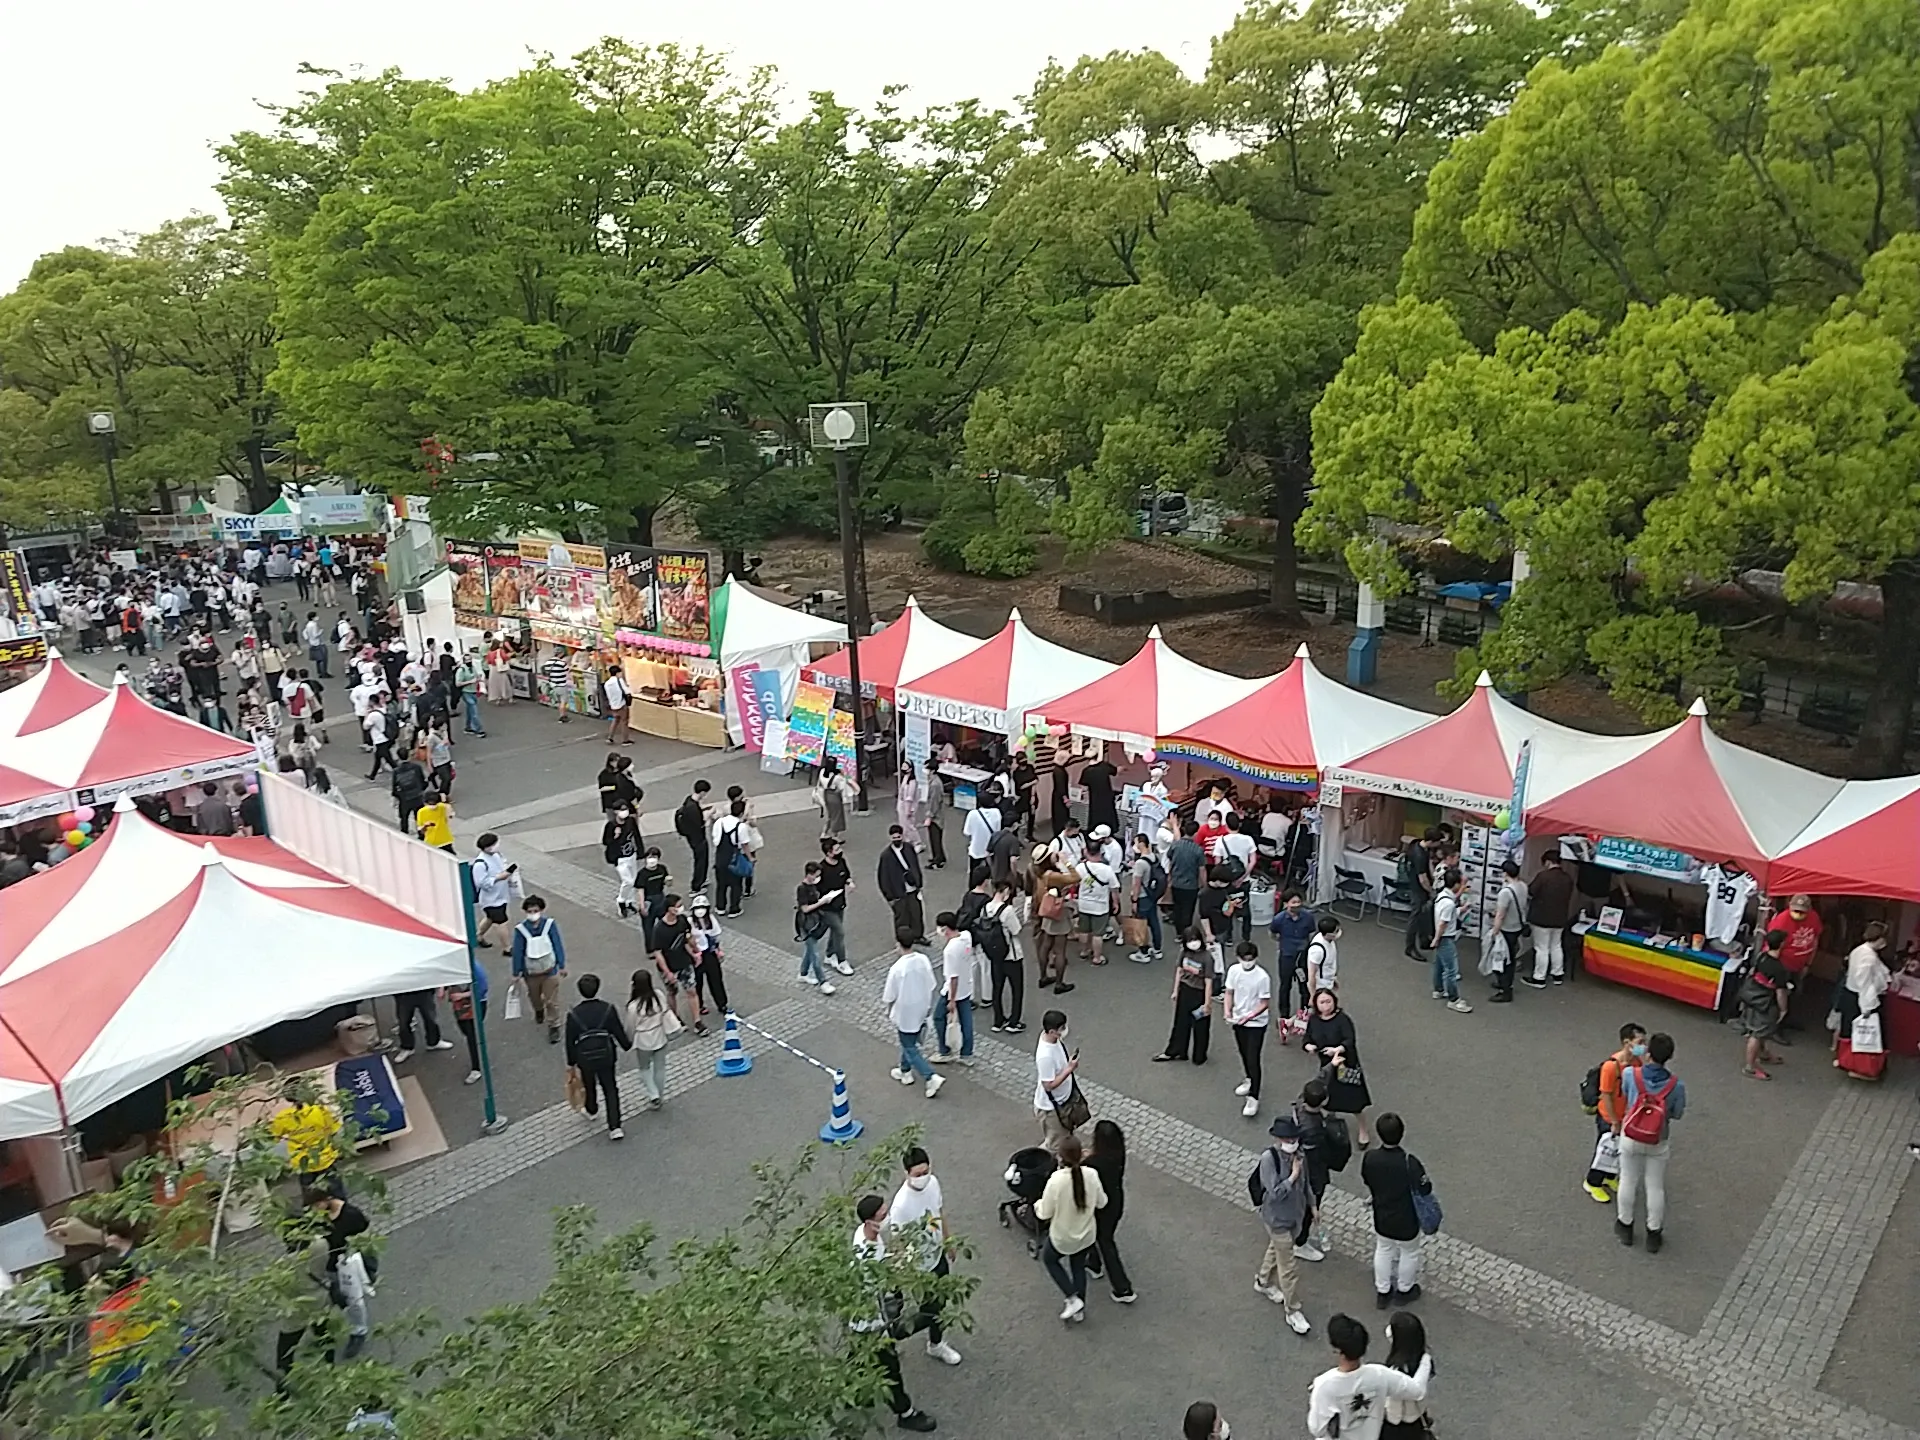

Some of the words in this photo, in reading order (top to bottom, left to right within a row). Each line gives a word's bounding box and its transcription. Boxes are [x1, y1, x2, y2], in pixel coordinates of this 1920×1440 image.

[224, 518, 256, 530] SKYY
[913, 696, 1006, 730] REIGETSU
[1162, 743, 1183, 753] LIVE
[1184, 745, 1210, 759] YOUR
[1209, 751, 1240, 770] PRIDE
[1240, 762, 1267, 779] WITH
[1268, 769, 1309, 784] KIEHL'S
